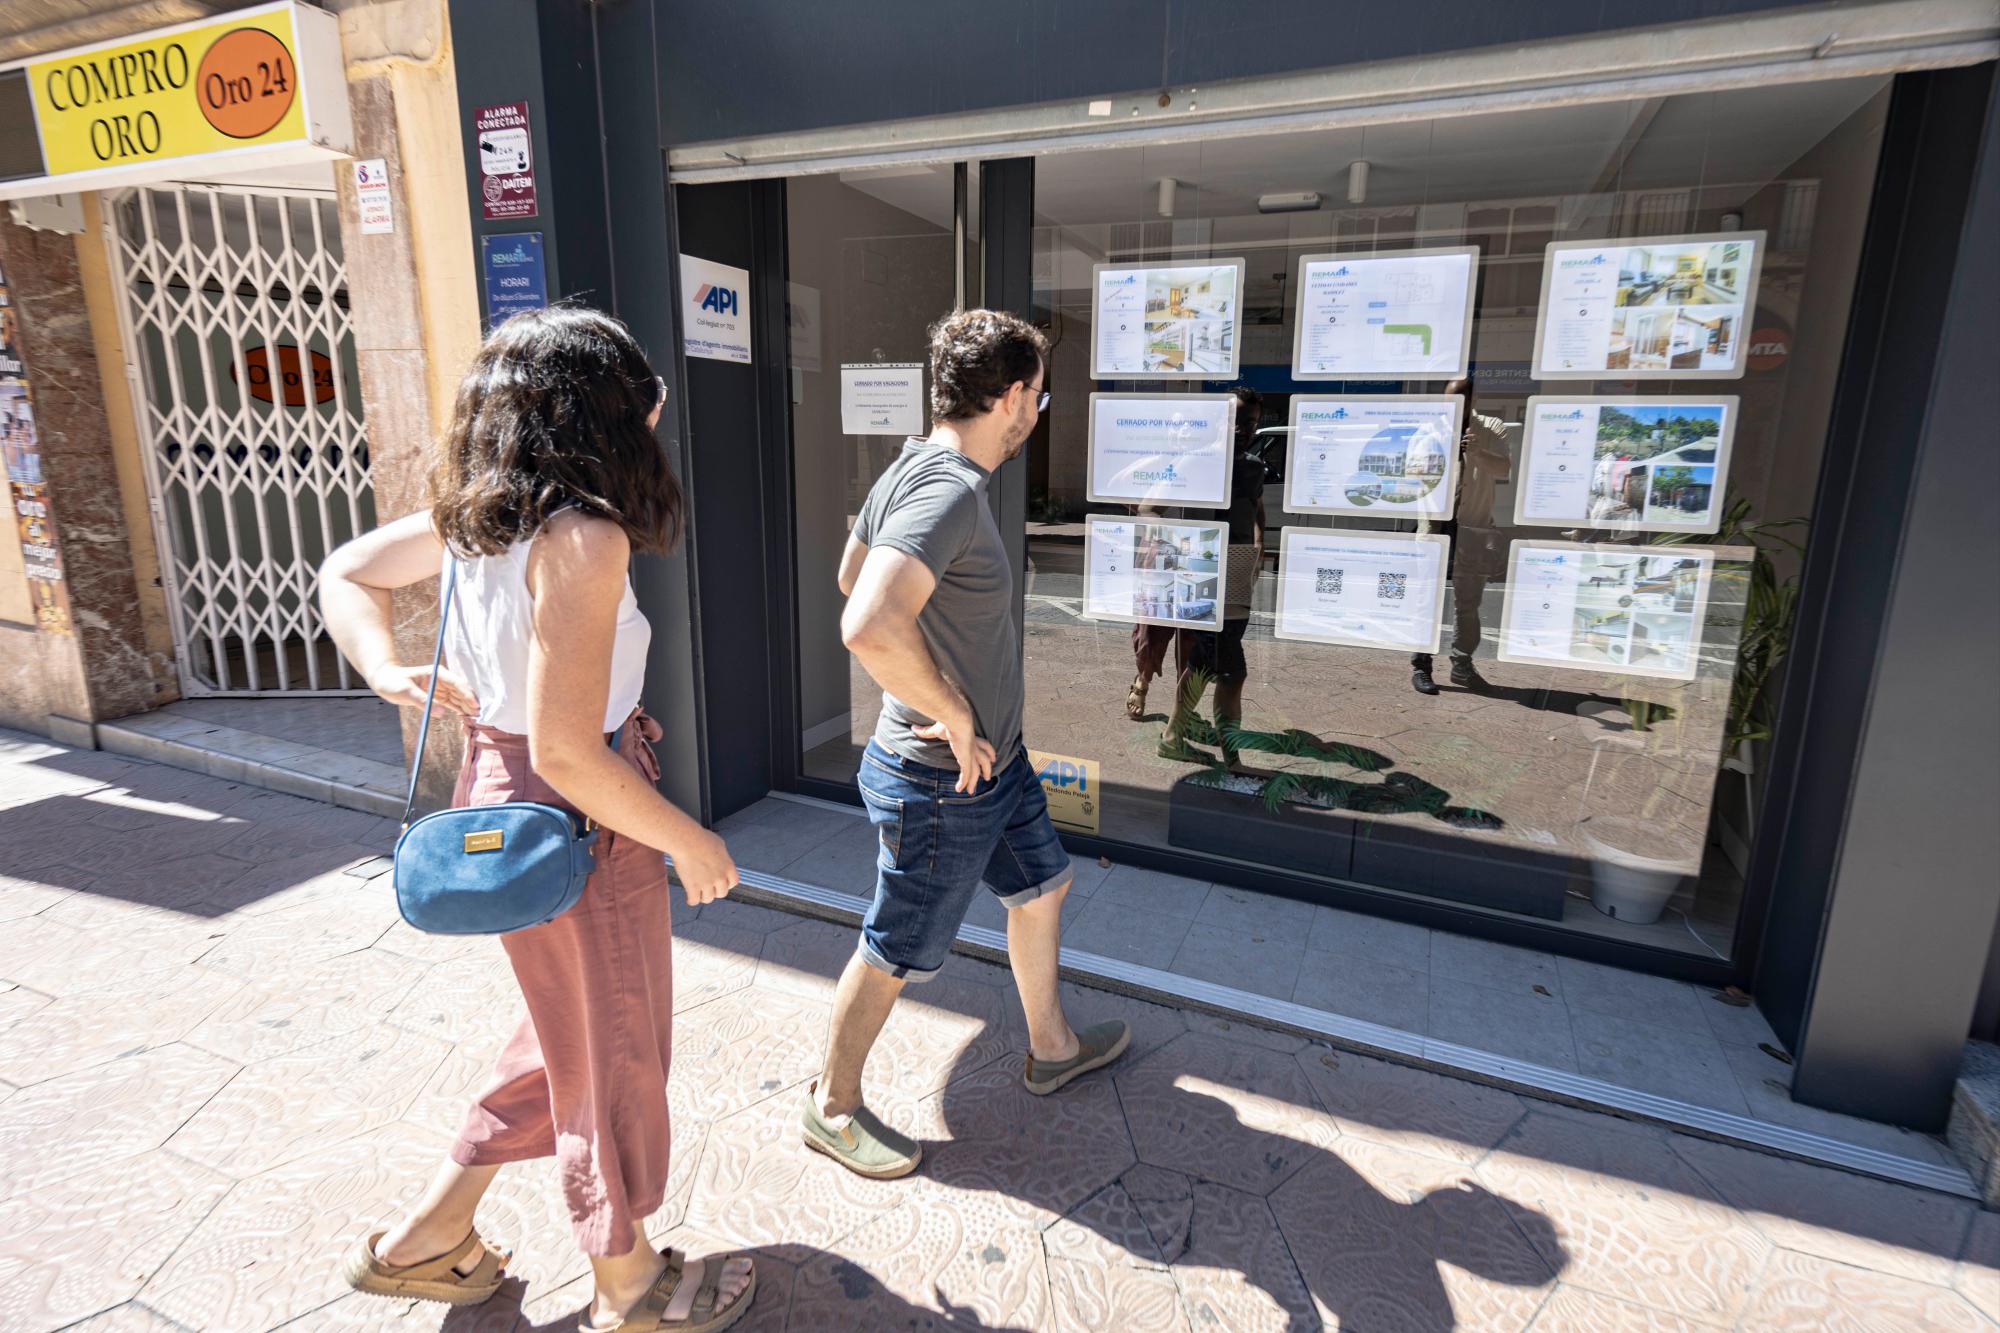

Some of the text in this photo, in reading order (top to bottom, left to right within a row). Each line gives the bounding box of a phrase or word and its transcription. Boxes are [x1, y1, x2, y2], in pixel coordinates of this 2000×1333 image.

[47, 43, 188, 111] COMPRO
[205, 57, 289, 110] Oro 24
[477, 115, 526, 130] CONECTADA
[484, 106, 518, 119] ALARMA
[90, 110, 161, 161] ORO
[702, 286, 737, 316] API
[1116, 418, 1208, 428] CERRADO POR VACACIONES
[1038, 760, 1086, 791] API
